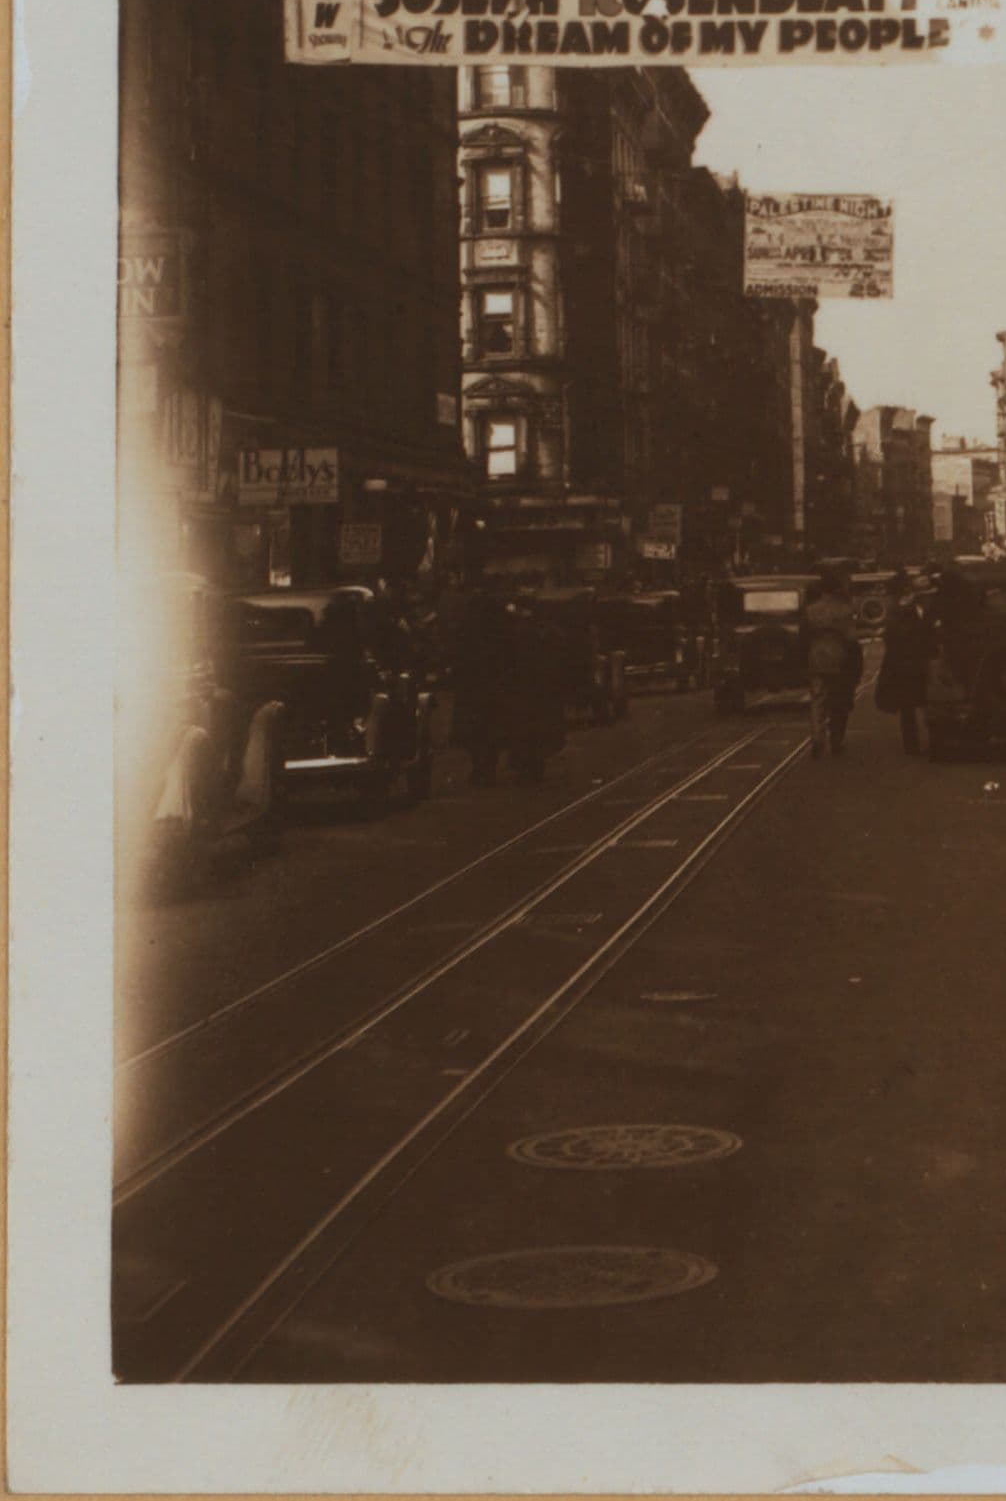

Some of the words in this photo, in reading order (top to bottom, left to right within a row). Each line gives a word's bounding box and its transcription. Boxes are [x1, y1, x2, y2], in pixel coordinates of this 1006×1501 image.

[464, 20, 630, 55] DREAM
[639, 19, 694, 55] OF
[700, 19, 768, 55] MY
[778, 18, 950, 54] PEOPLE
